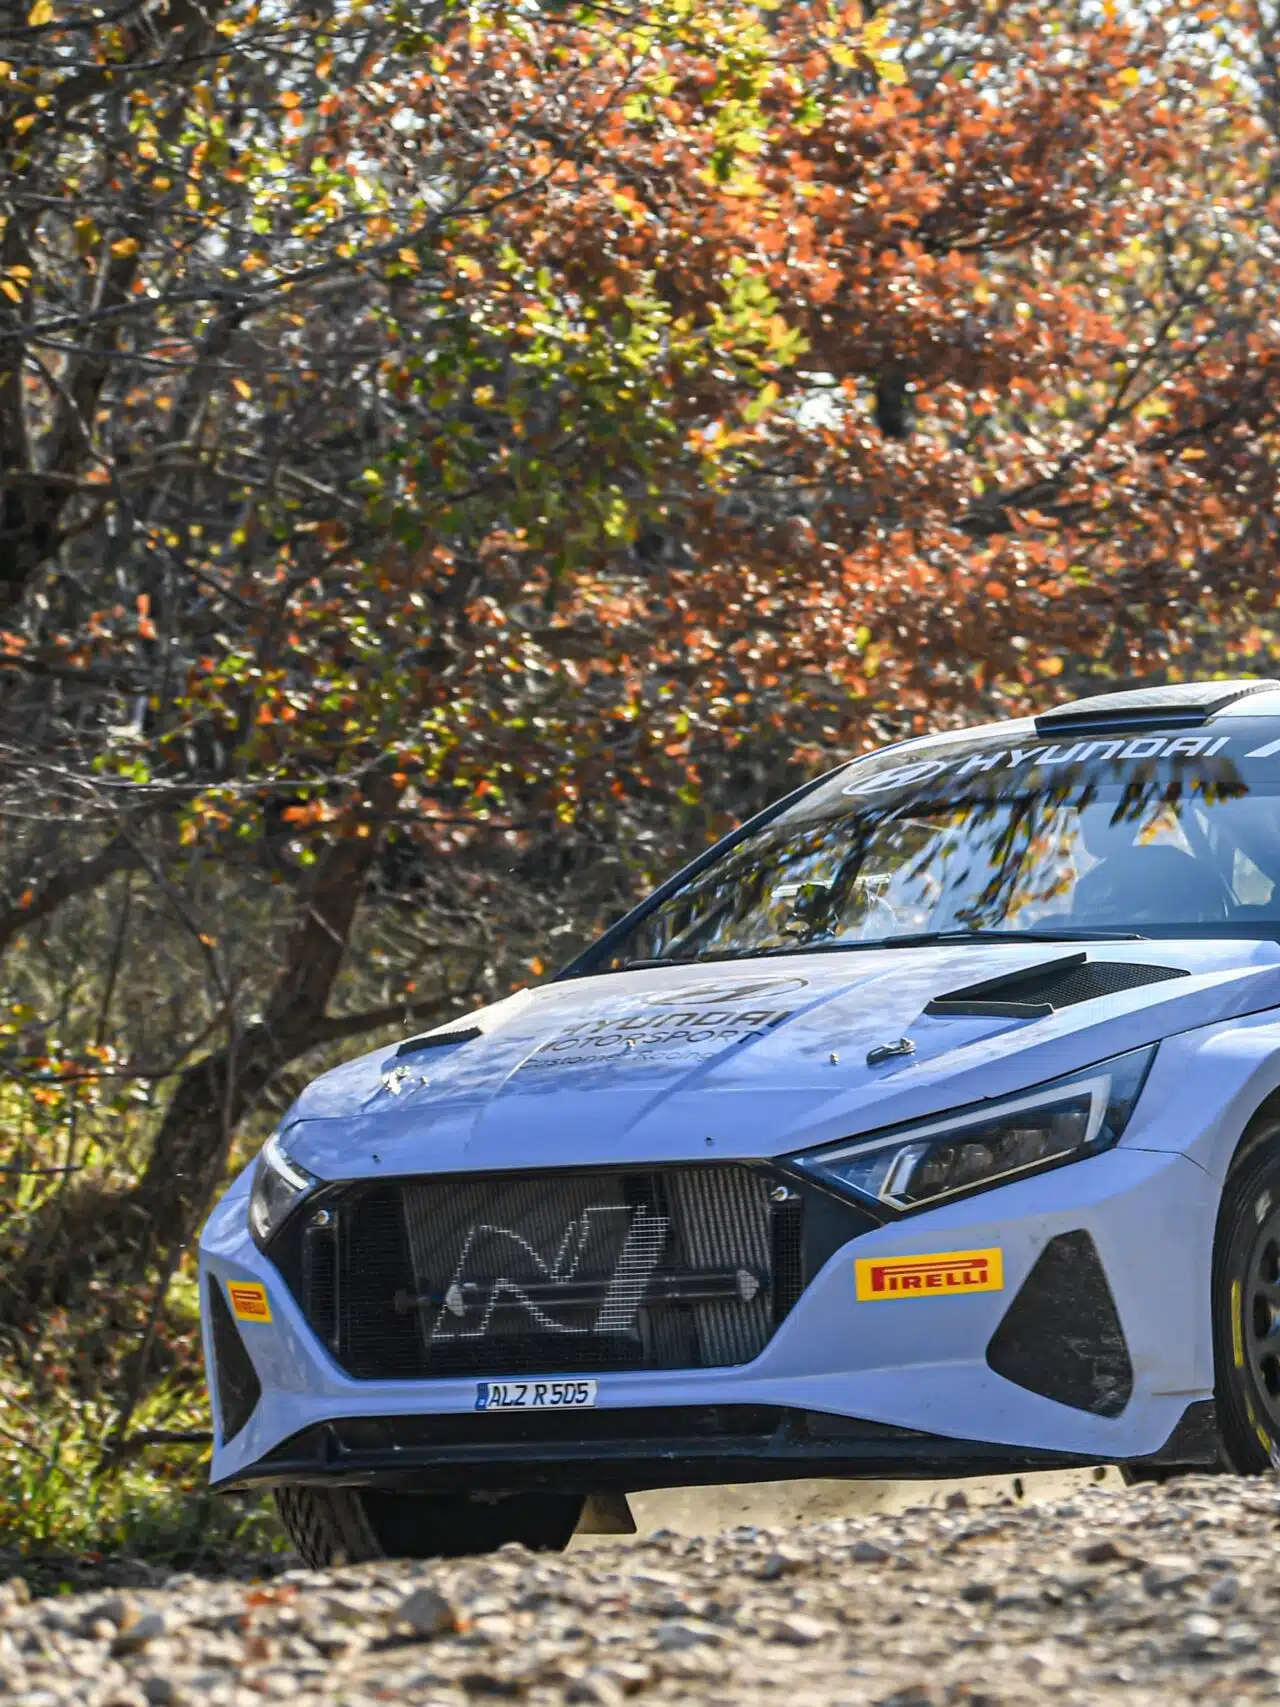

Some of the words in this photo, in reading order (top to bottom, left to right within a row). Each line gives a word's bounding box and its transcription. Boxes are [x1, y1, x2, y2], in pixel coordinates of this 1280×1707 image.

[956, 736, 1231, 775] HYUNDAI
[871, 1258, 988, 1292] PIRELLI
[488, 1384, 528, 1407] ALZ
[533, 1384, 548, 1406] R
[550, 1382, 589, 1405] 505
